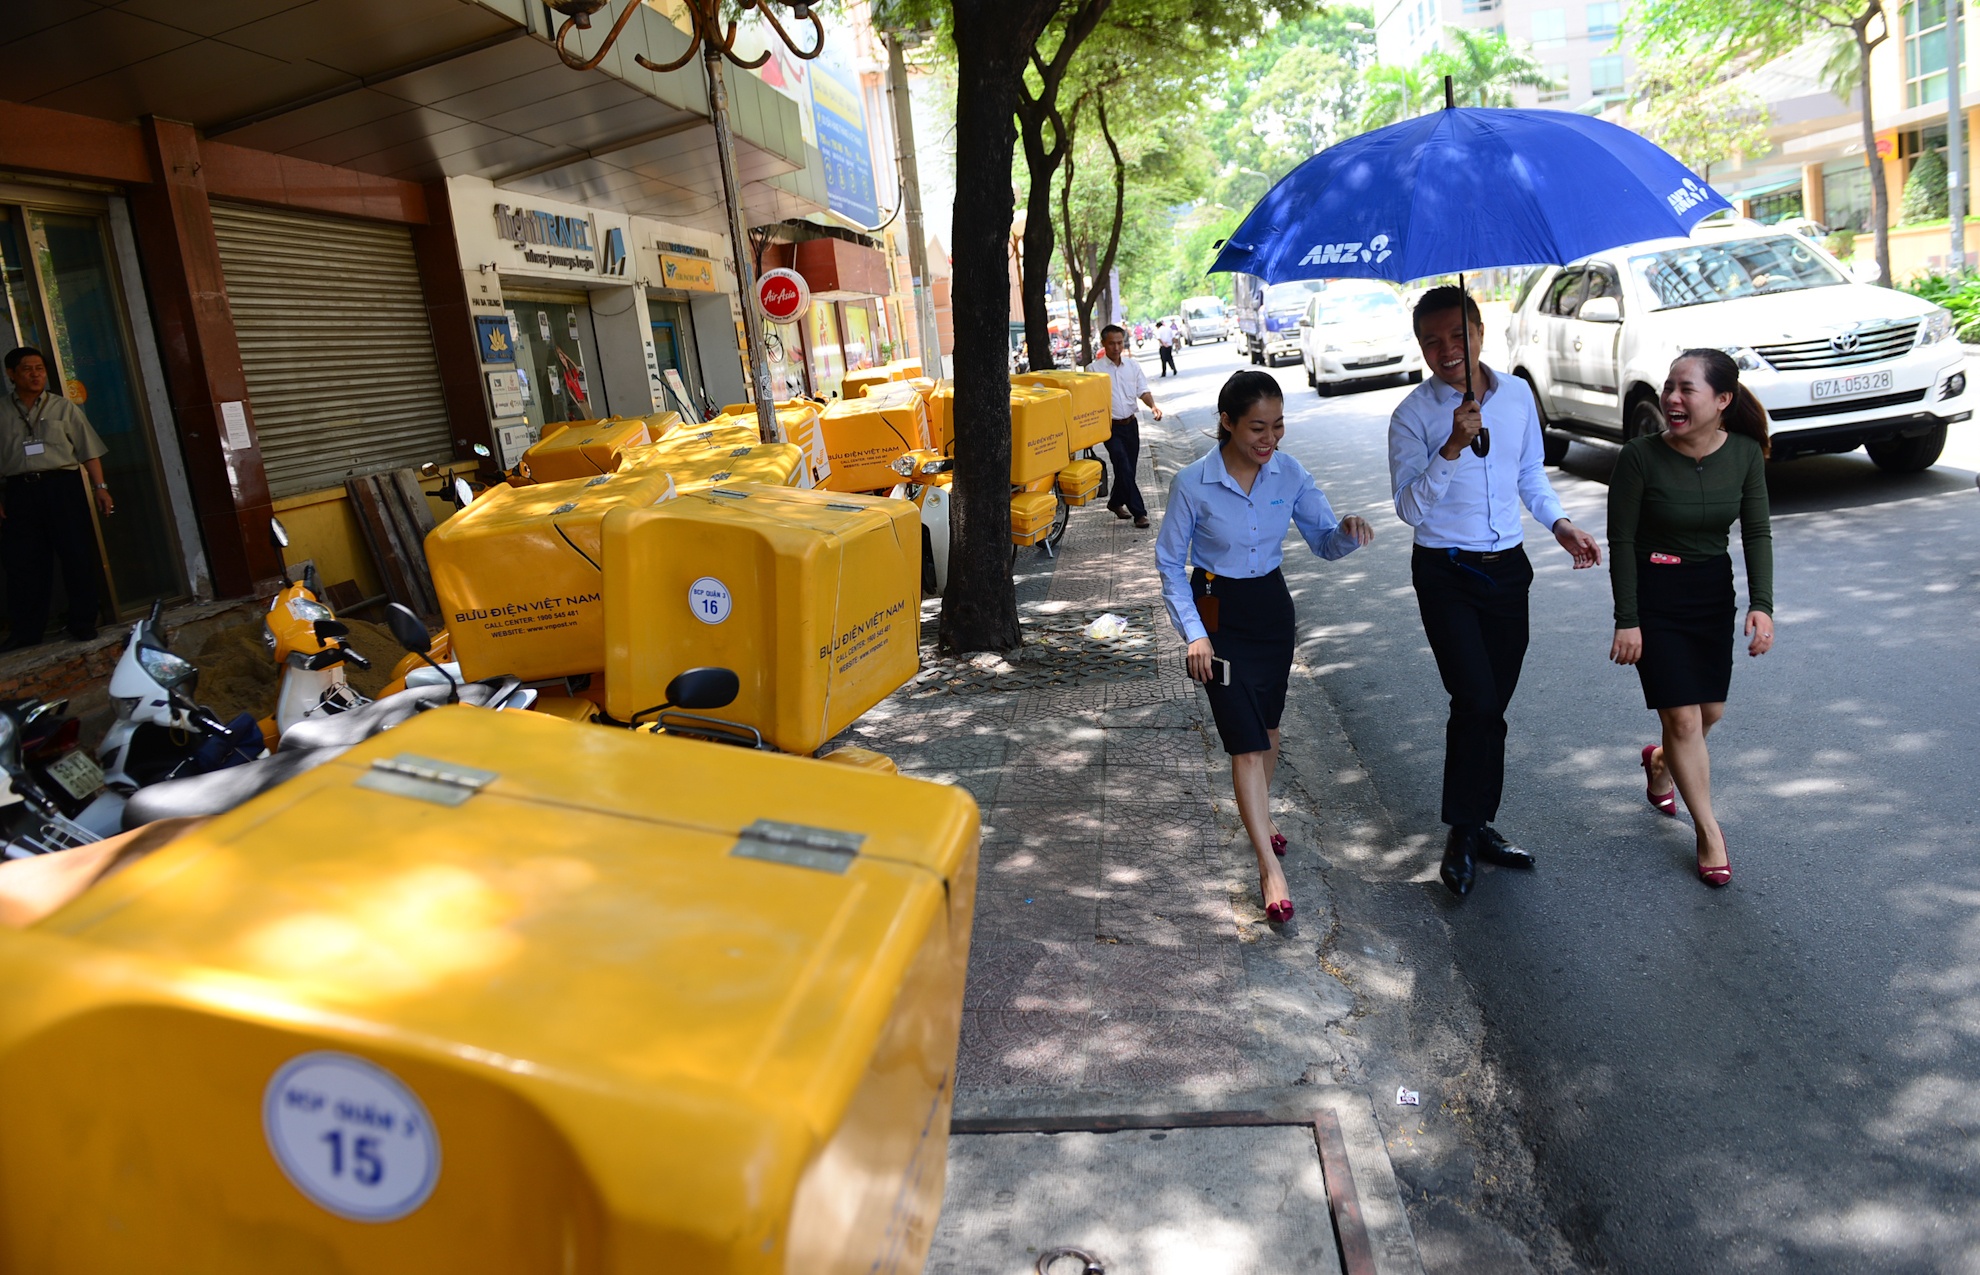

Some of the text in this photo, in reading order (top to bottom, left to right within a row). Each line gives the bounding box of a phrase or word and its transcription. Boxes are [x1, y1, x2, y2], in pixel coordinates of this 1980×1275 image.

[1667, 188, 1698, 216] ANZ
[1298, 242, 1363, 266] ANZ
[455, 592, 601, 623] BƯU ĐIỆN VIỆT NAM
[702, 599, 718, 615] 16
[484, 609, 579, 630] CALL CENTER: 1900 545 481
[491, 620, 578, 638] WEBSITE: www.vnpost.vn
[842, 623, 865, 646] ĐIỆN
[865, 611, 885, 630] VIỆT
[886, 599, 905, 619] NAM
[836, 652, 848, 663] CALL
[320, 1130, 384, 1187] 15
